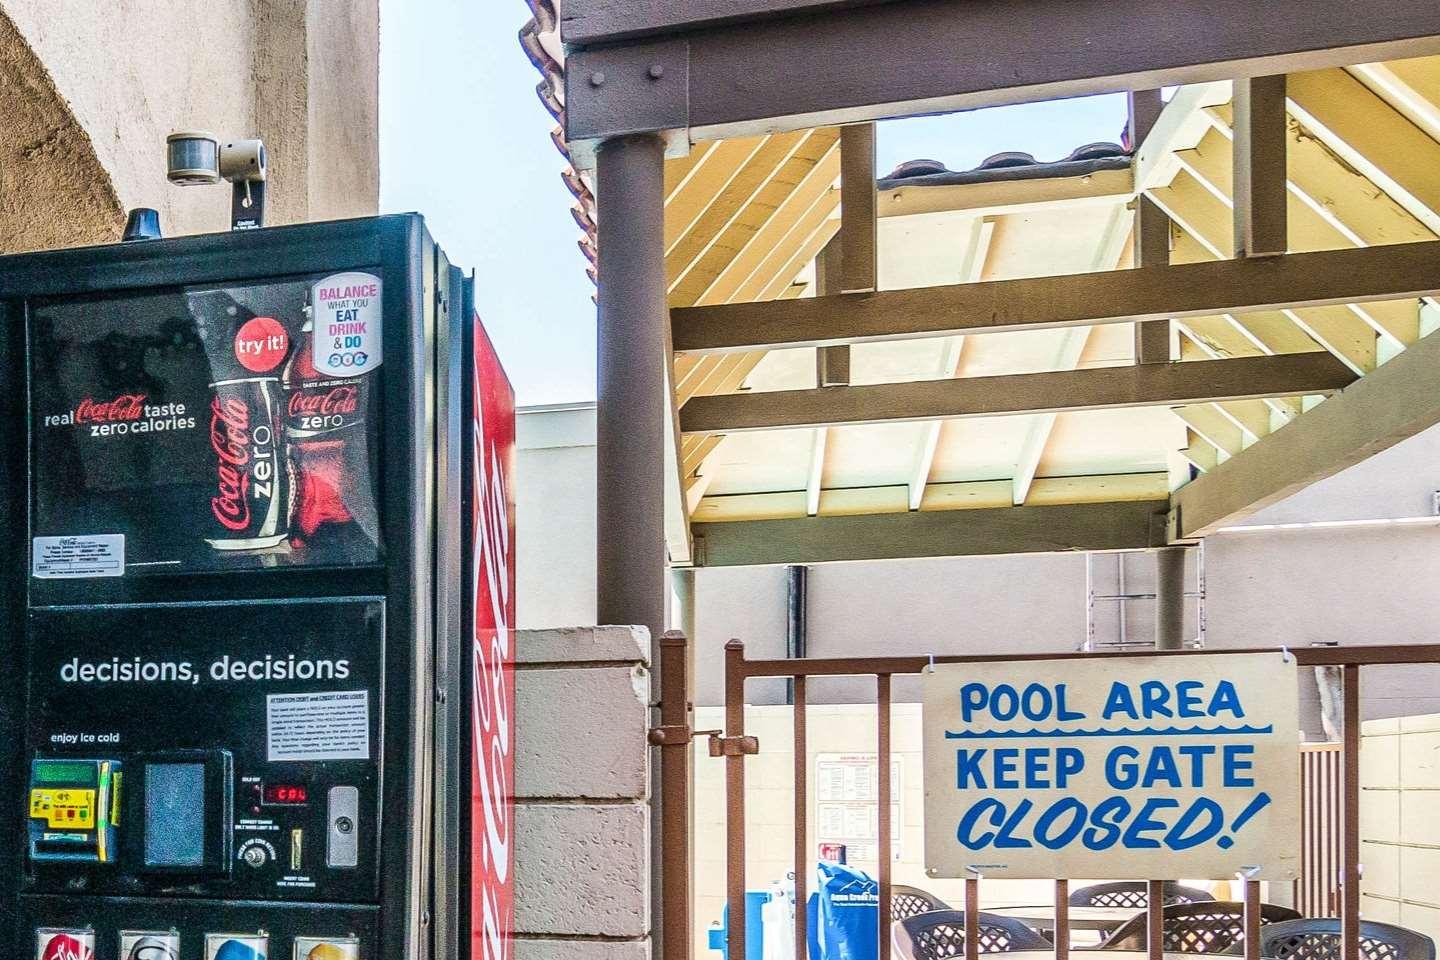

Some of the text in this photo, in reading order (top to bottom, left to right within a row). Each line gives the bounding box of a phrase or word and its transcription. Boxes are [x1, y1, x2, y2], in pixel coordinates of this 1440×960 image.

[319, 284, 377, 300] BALANCE
[328, 298, 369, 310] WHAT YOU
[336, 309, 359, 322] EAT
[329, 322, 367, 336] DRINK
[238, 334, 285, 356] try it!
[333, 336, 362, 349] & DO
[45, 393, 186, 427] real Coca-Cola taste
[288, 386, 357, 417] Coca-Cola
[91, 416, 196, 437] zero calories
[301, 414, 343, 429] zero
[210, 396, 250, 530] Coca-Cola
[253, 426, 271, 499] zero
[60, 654, 350, 685] decisions, decisions
[960, 680, 1245, 723] POOL AREA
[50, 732, 120, 744] enjoy ice cold
[956, 745, 1255, 790] KEEP GATE
[956, 792, 1272, 851] CLOSED!
